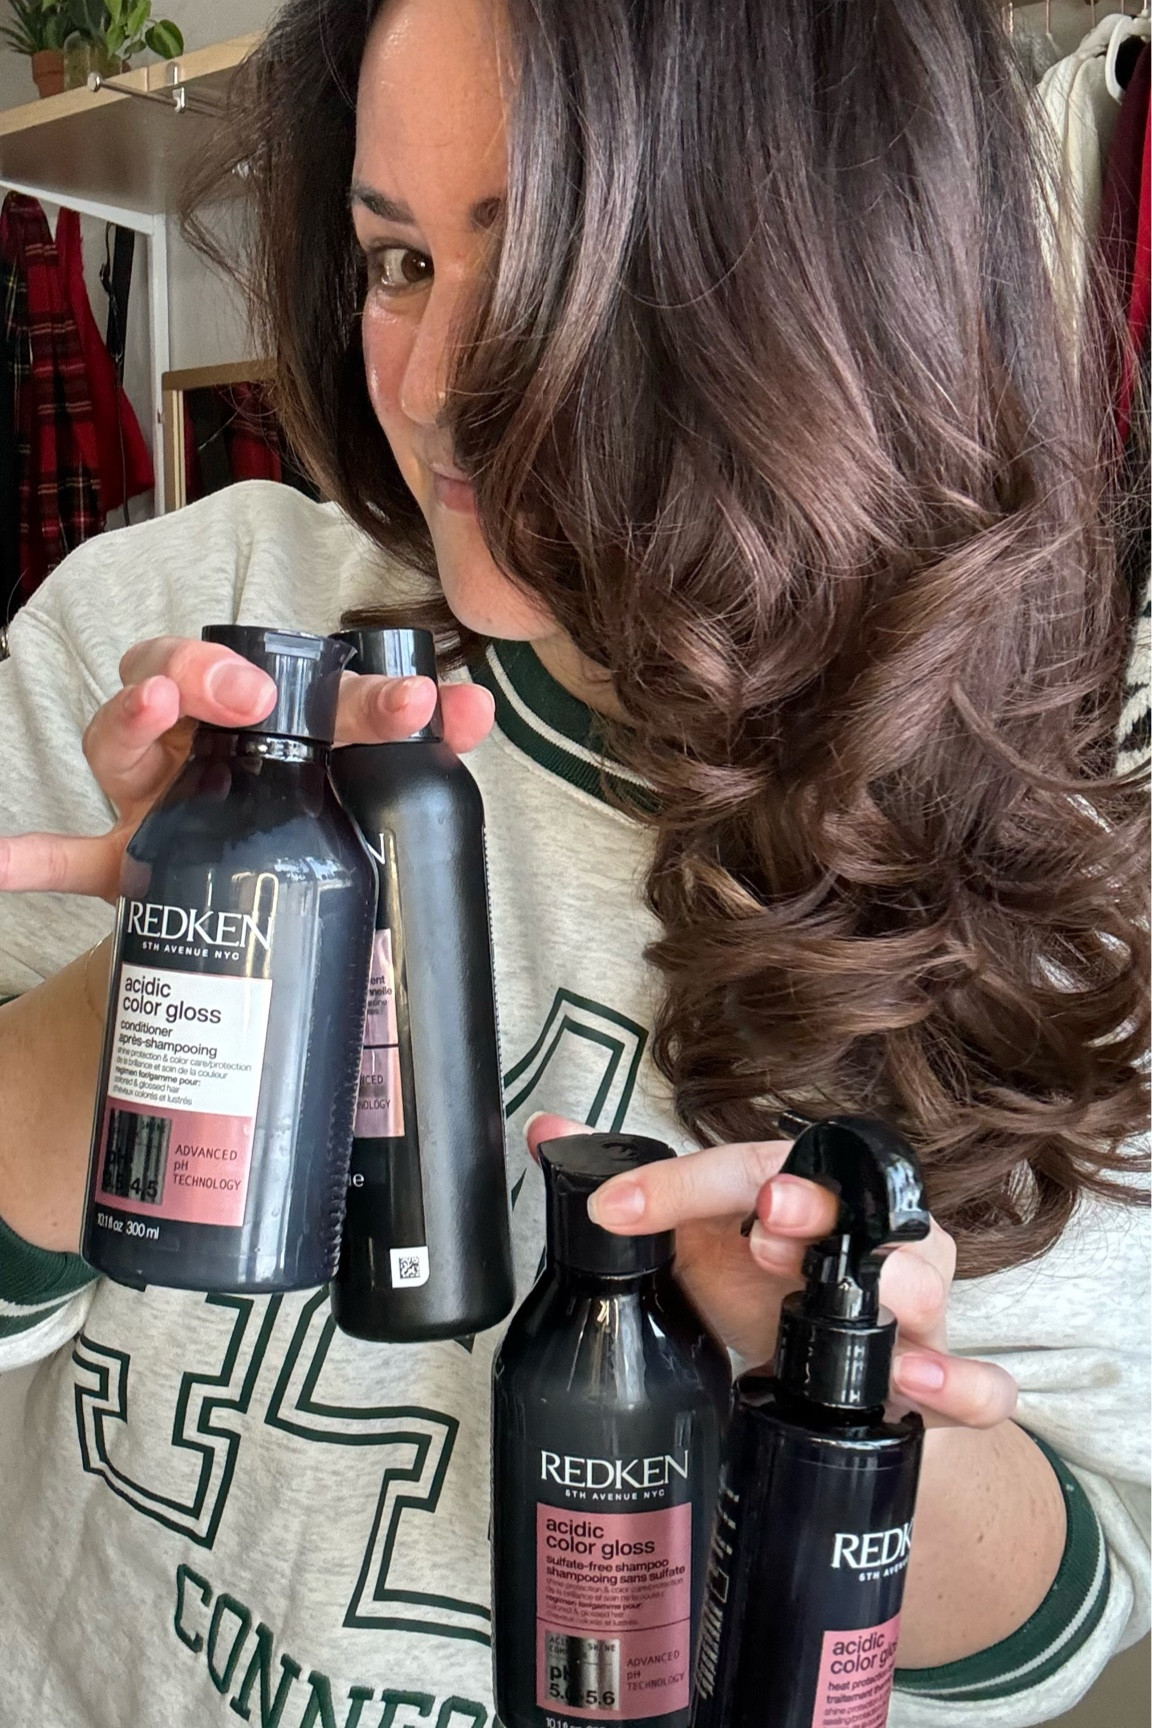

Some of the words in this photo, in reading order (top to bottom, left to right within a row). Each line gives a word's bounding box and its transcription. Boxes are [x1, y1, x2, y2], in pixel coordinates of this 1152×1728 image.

[127, 901, 272, 950] REDKEN
[142, 941, 160, 951] 5TH
[164, 945, 208, 957] AVENUE
[215, 951, 240, 961] NYC
[125, 976, 171, 998] acidic
[123, 995, 162, 1016] color
[166, 1001, 221, 1024] gloss
[120, 1020, 173, 1038] conditioner
[118, 1033, 217, 1059] après-shampooing
[170, 1055, 188, 1064] color
[162, 1063, 176, 1073] soin
[178, 1066, 188, 1075] de
[190, 1067, 196, 1076] la
[174, 1145, 237, 1161] ADVANCED
[174, 1160, 189, 1172] pH
[173, 1173, 241, 1191] TECHNOLOGY
[126, 1220, 146, 1238] 300
[146, 1226, 160, 1240] ml
[540, 1450, 688, 1489] REDKEN
[565, 1489, 586, 1499] 5TH
[592, 1492, 637, 1501] AVENUE
[644, 1489, 665, 1499] NYC
[546, 1518, 604, 1539] acidic
[546, 1535, 596, 1555] color
[601, 1540, 655, 1560] gloss
[546, 1555, 612, 1572] sulfate-free
[615, 1558, 669, 1574] shampoo
[546, 1566, 617, 1586] shampooing
[620, 1574, 647, 1584] sans
[650, 1565, 686, 1580] sulfate
[588, 1642, 615, 1651] SHNE
[832, 1632, 884, 1656] acidic
[627, 1650, 680, 1667] ADVANCED
[830, 1653, 877, 1674] color
[627, 1671, 640, 1680] pH
[627, 1672, 685, 1691] TECHNOLOGY
[586, 1690, 615, 1705] 5.6
